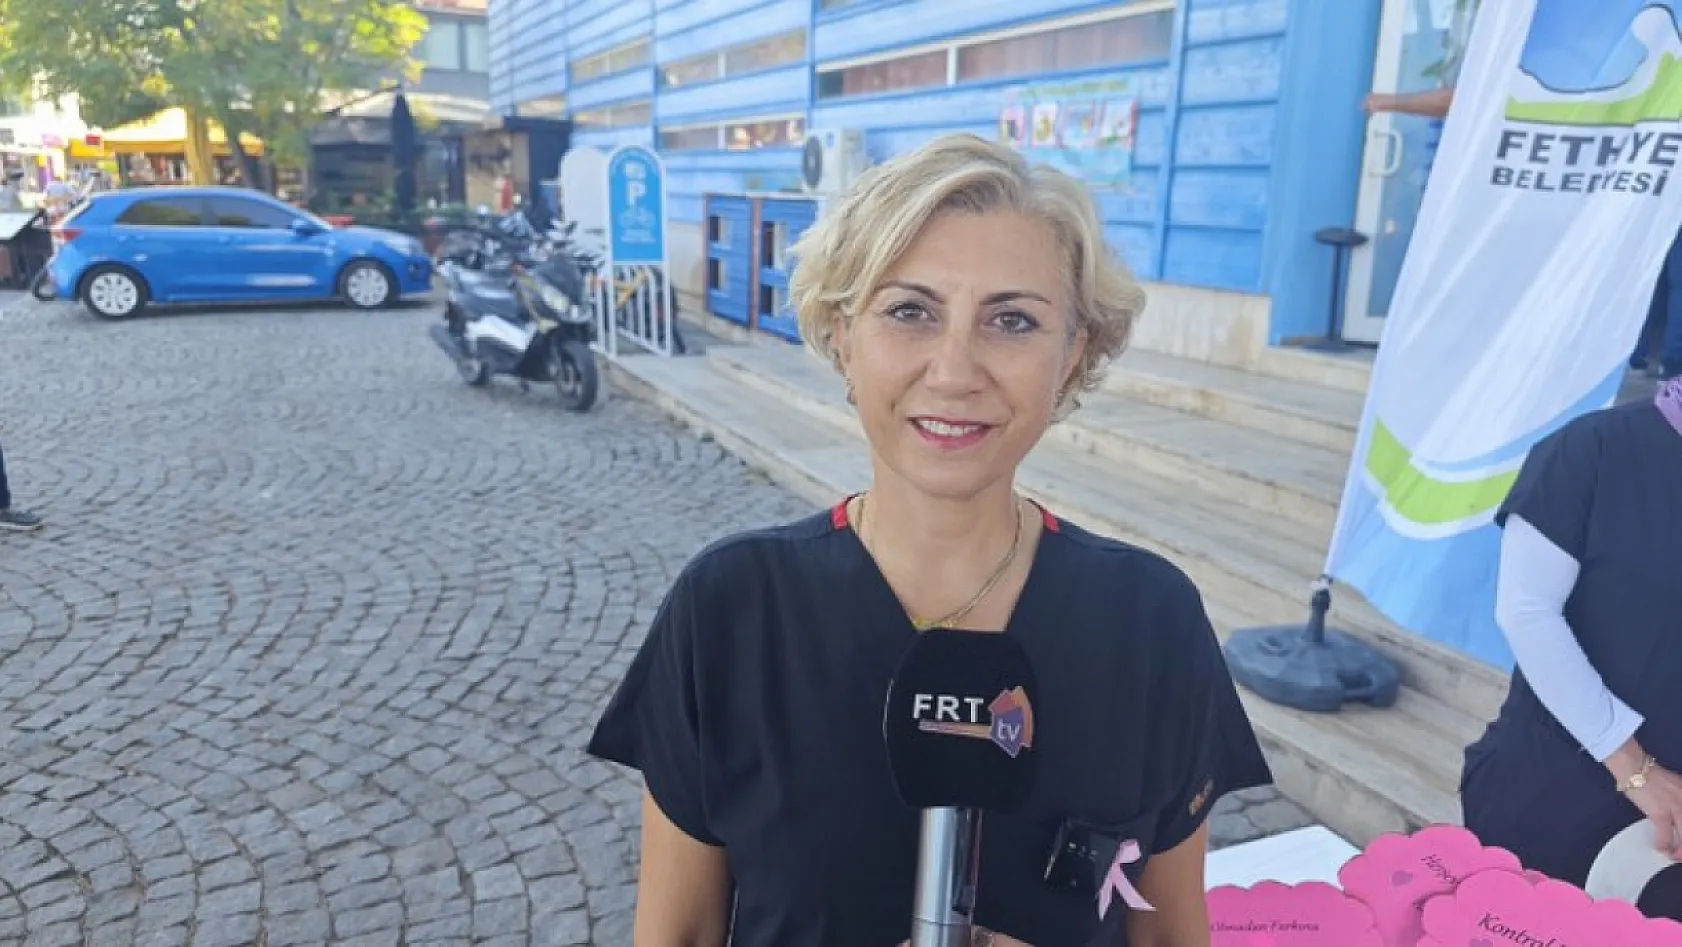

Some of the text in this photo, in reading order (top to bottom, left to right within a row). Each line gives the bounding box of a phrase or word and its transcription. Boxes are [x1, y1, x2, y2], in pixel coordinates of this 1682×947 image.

[1496, 130, 1682, 166] FETHYE
[627, 181, 647, 206] P
[1490, 165, 1670, 197] BELEYESİ
[913, 693, 985, 723] FRT
[998, 717, 1021, 742] tv
